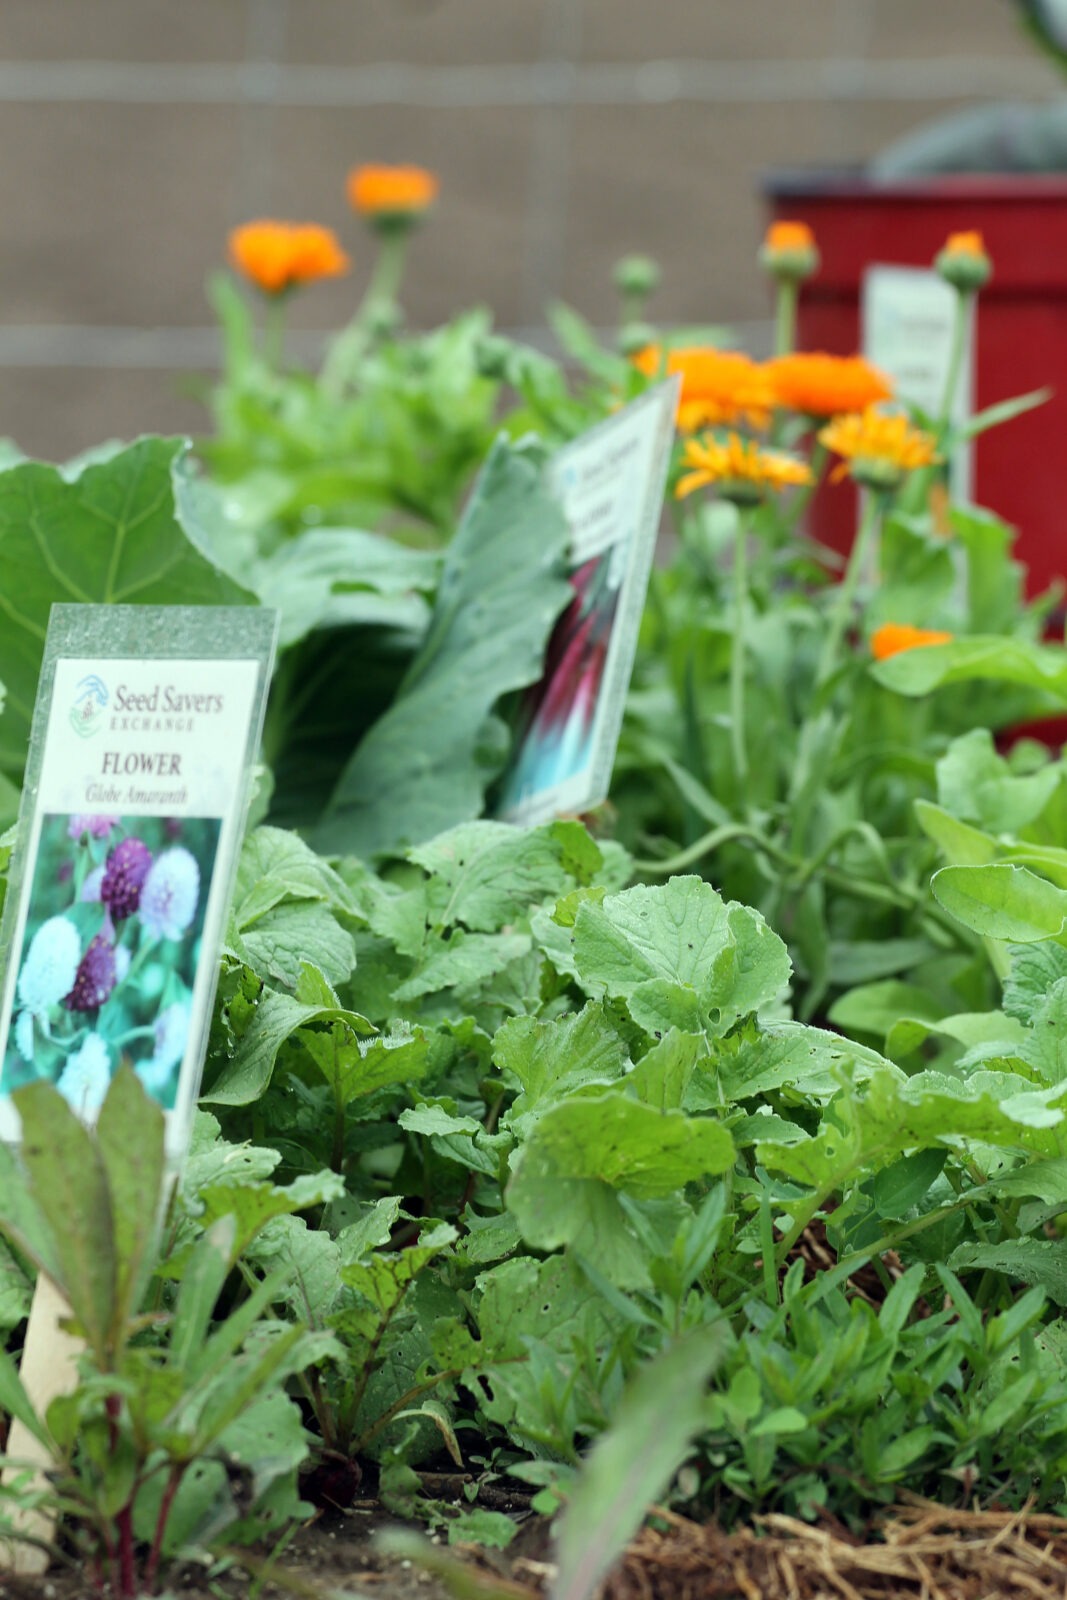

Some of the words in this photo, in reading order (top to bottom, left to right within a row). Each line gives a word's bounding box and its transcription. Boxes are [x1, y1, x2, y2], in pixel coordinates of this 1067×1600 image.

[113, 684, 160, 713] Seed
[161, 685, 224, 714] Savers
[109, 716, 194, 732] EXCHANGE
[101, 751, 182, 776] FLOWER
[85, 783, 122, 804] Globe
[123, 785, 188, 805] Amaranth
